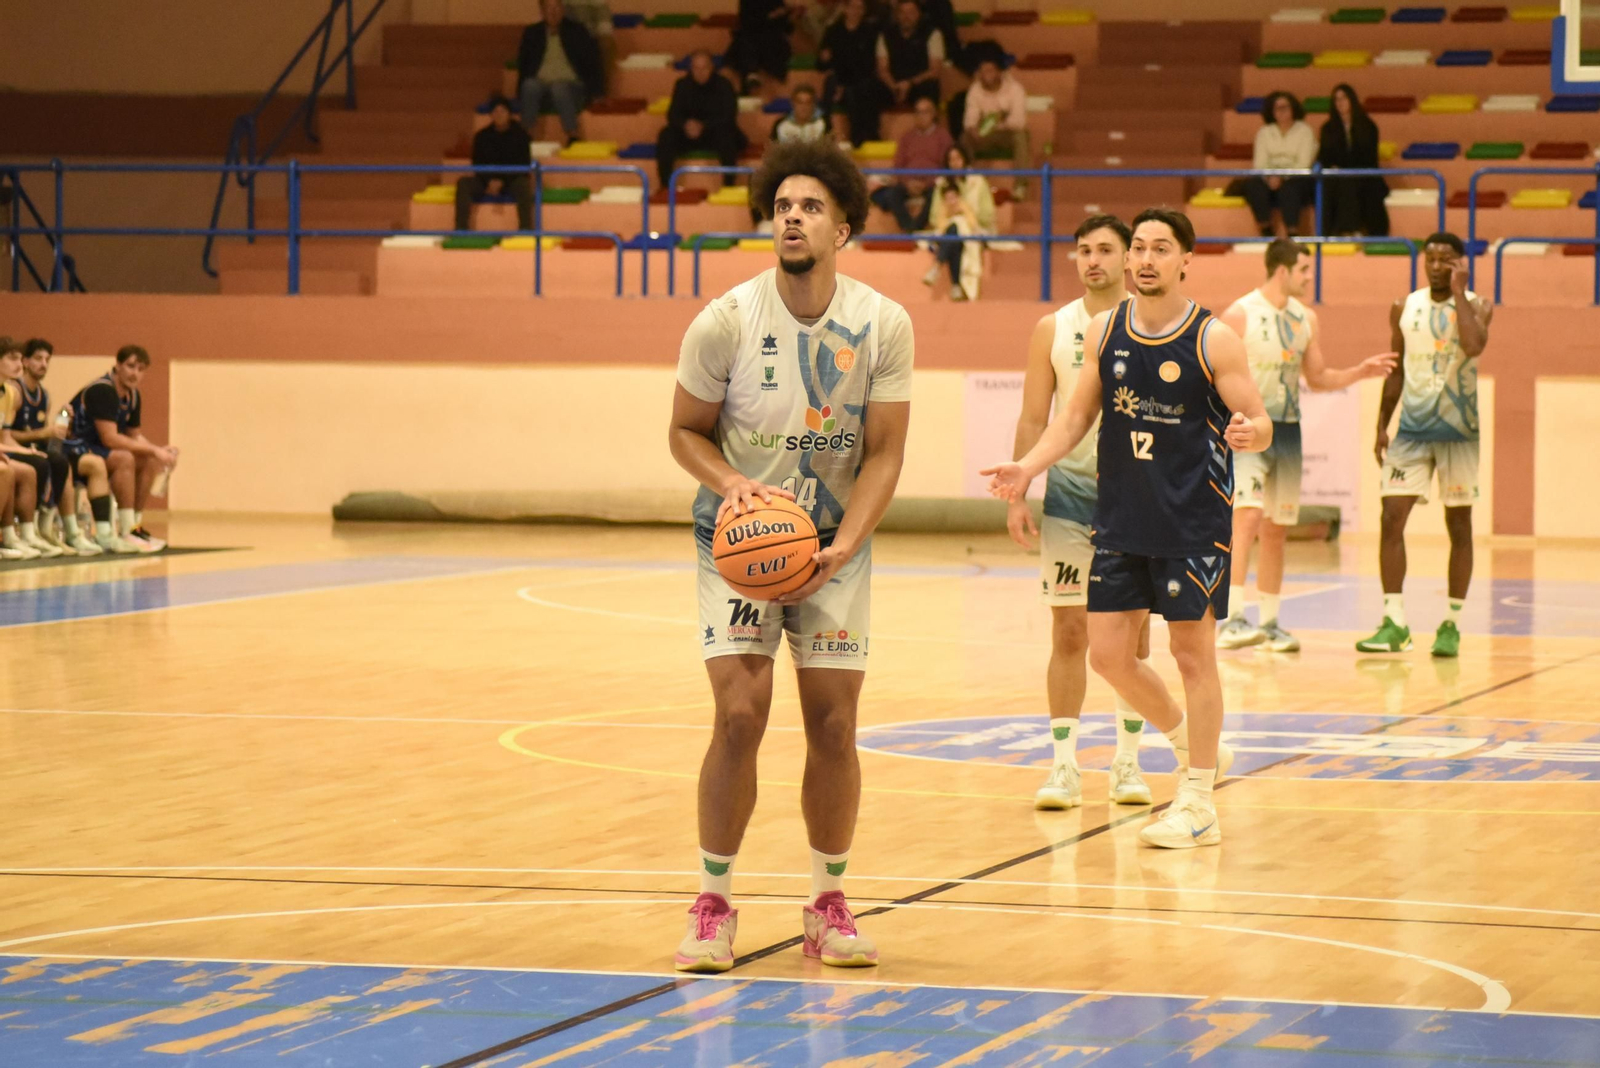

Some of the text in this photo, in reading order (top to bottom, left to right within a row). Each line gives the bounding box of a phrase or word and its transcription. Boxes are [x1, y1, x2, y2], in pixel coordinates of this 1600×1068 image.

[749, 428, 856, 451] surseeds
[1130, 431, 1154, 460] 12
[781, 477, 817, 511] 14
[725, 519, 797, 547] Wilson
[746, 555, 787, 578] EVO
[812, 641, 859, 652] EL EJIDO
